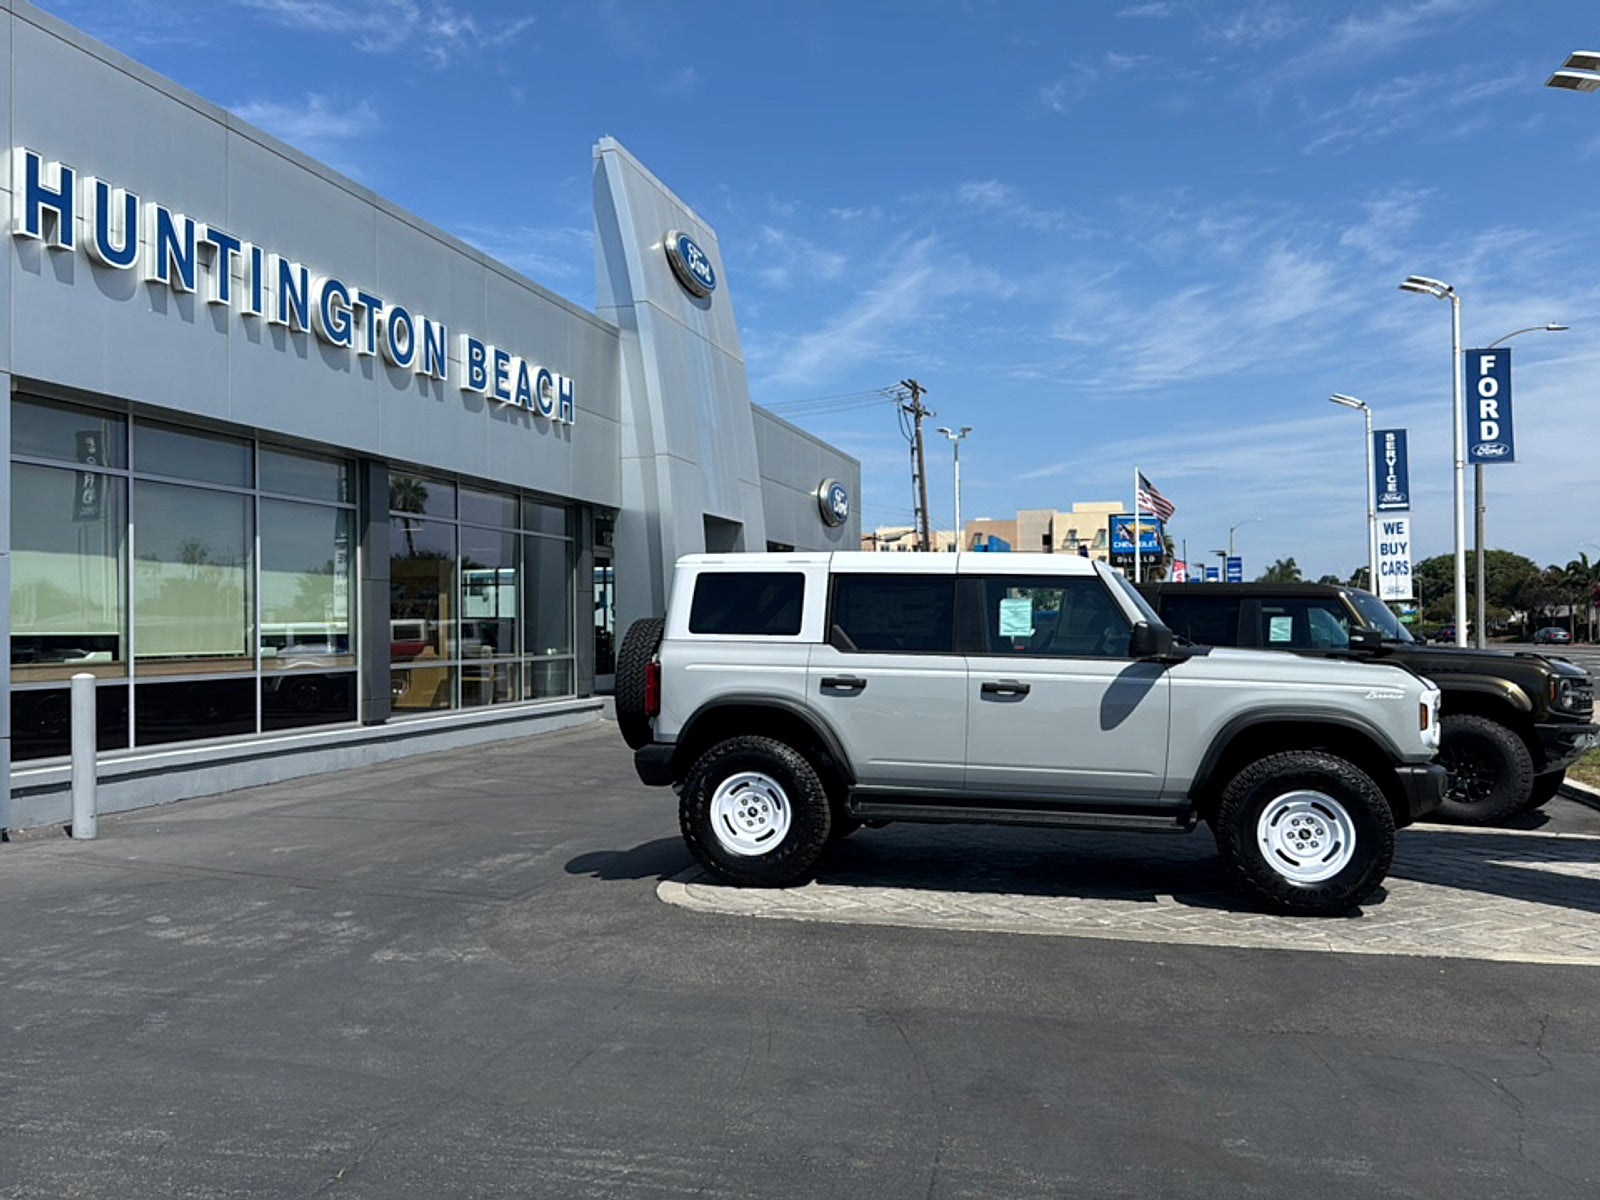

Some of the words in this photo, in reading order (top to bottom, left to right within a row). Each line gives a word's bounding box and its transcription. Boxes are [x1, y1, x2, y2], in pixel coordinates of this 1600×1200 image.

[686, 242, 712, 282] Ford
[13, 147, 448, 380] HUNTINGTON
[460, 333, 575, 425] BEACH
[1478, 354, 1500, 441] FORD
[1477, 444, 1506, 457] Ford
[1385, 432, 1397, 492] SERVICE
[833, 488, 848, 516] Ford
[1383, 521, 1404, 535] WE
[1113, 540, 1158, 548] CHEVOLET
[1380, 542, 1407, 556] BUY
[1381, 560, 1410, 577] CARS
